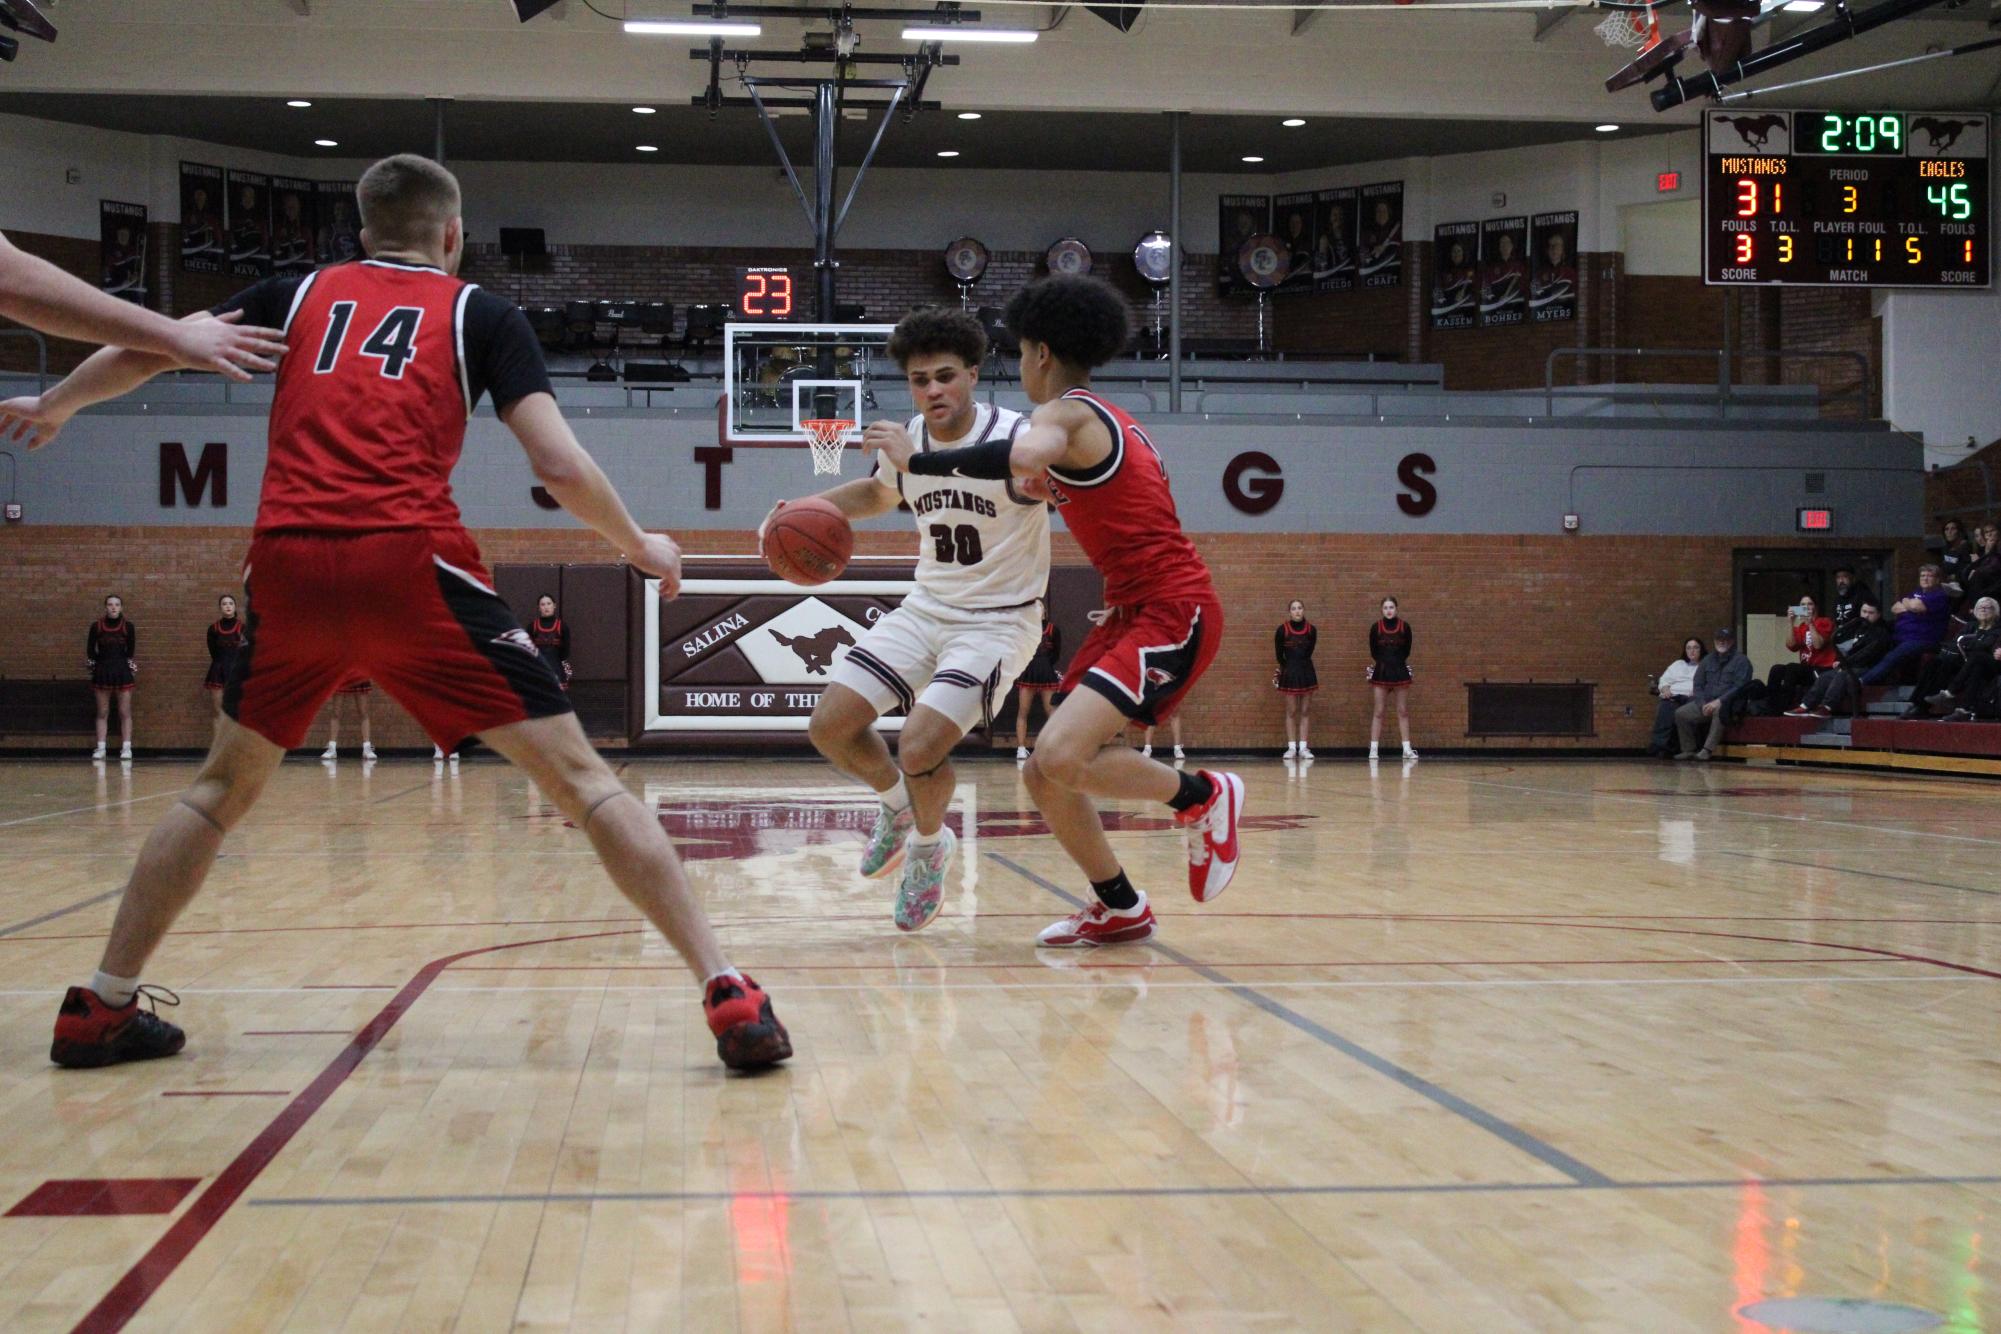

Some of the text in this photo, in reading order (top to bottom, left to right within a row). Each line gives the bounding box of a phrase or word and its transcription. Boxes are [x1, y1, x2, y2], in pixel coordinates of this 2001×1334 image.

[1821, 115, 1899, 151] 2:09
[1721, 157, 1787, 174] MUSTANGS
[1829, 169, 1868, 181] PERIOD
[1919, 160, 1965, 178] EAGLES
[1737, 180, 1781, 215] 31
[1843, 186, 1857, 213] 3
[1927, 183, 1970, 219] 45
[1721, 220, 1757, 232] FOULS
[1770, 221, 1799, 232] T.O.L.
[1813, 222, 1886, 234] PLAYER FOUL
[1899, 223, 1928, 234] T.O.L.
[1940, 223, 1975, 235] FOULS
[1737, 234, 1752, 262] 3
[1778, 235, 1793, 262] 3
[1905, 237, 1921, 263] 5
[1965, 239, 1972, 262] 1
[1721, 268, 1757, 280] SCORE
[1829, 270, 1868, 281] MATCH
[1941, 271, 1975, 283] SCORE
[743, 274, 791, 315] 23
[1536, 308, 1572, 320] MYERS
[313, 300, 425, 380] 14
[913, 488, 997, 518] MUSTANGS
[929, 523, 984, 566] 30
[682, 612, 750, 658] SALINA
[685, 692, 741, 708] HOME
[750, 692, 775, 708] OF
